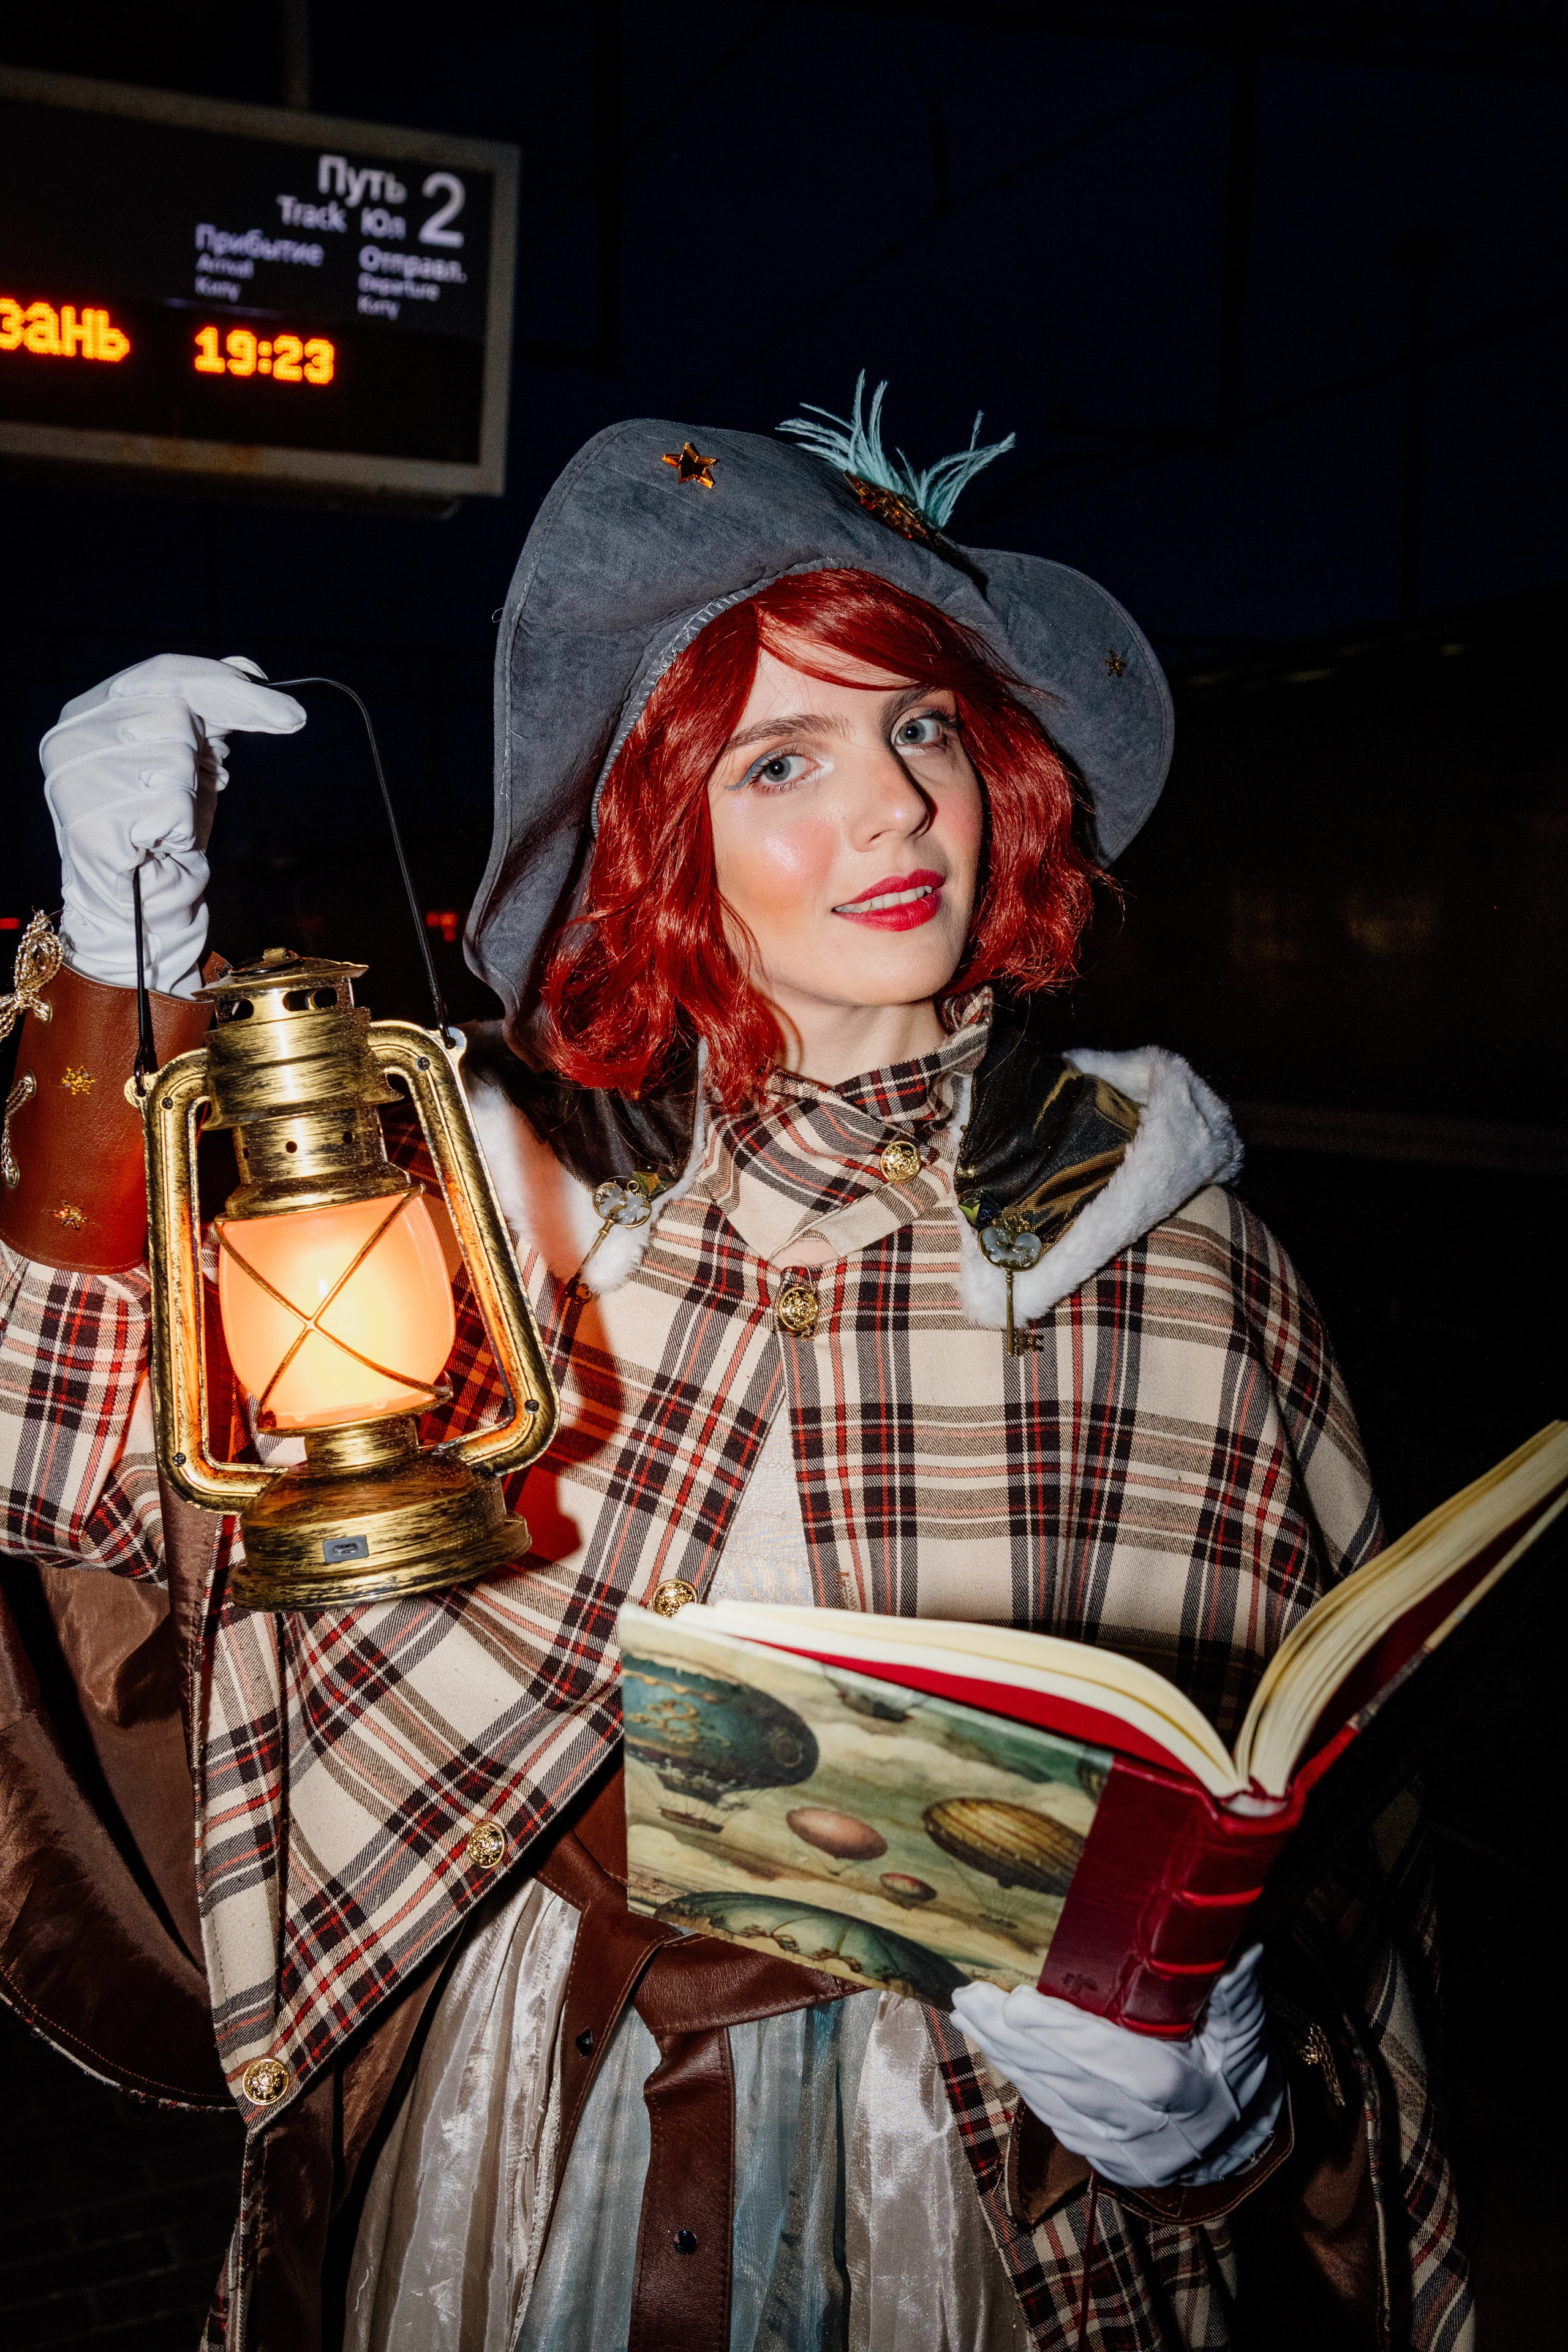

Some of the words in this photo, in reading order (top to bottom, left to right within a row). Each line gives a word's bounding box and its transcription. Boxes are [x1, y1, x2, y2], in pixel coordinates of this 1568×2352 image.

[277, 194, 347, 233] Track
[361, 207, 406, 240] Юл
[317, 154, 407, 208] Путь
[418, 172, 466, 247] 2
[195, 223, 324, 266] Прибытие
[195, 253, 254, 279] Arrival
[358, 245, 467, 284] Отправл.
[358, 272, 440, 301] Departure
[0, 298, 130, 362] зань
[195, 325, 334, 385] 19:23
